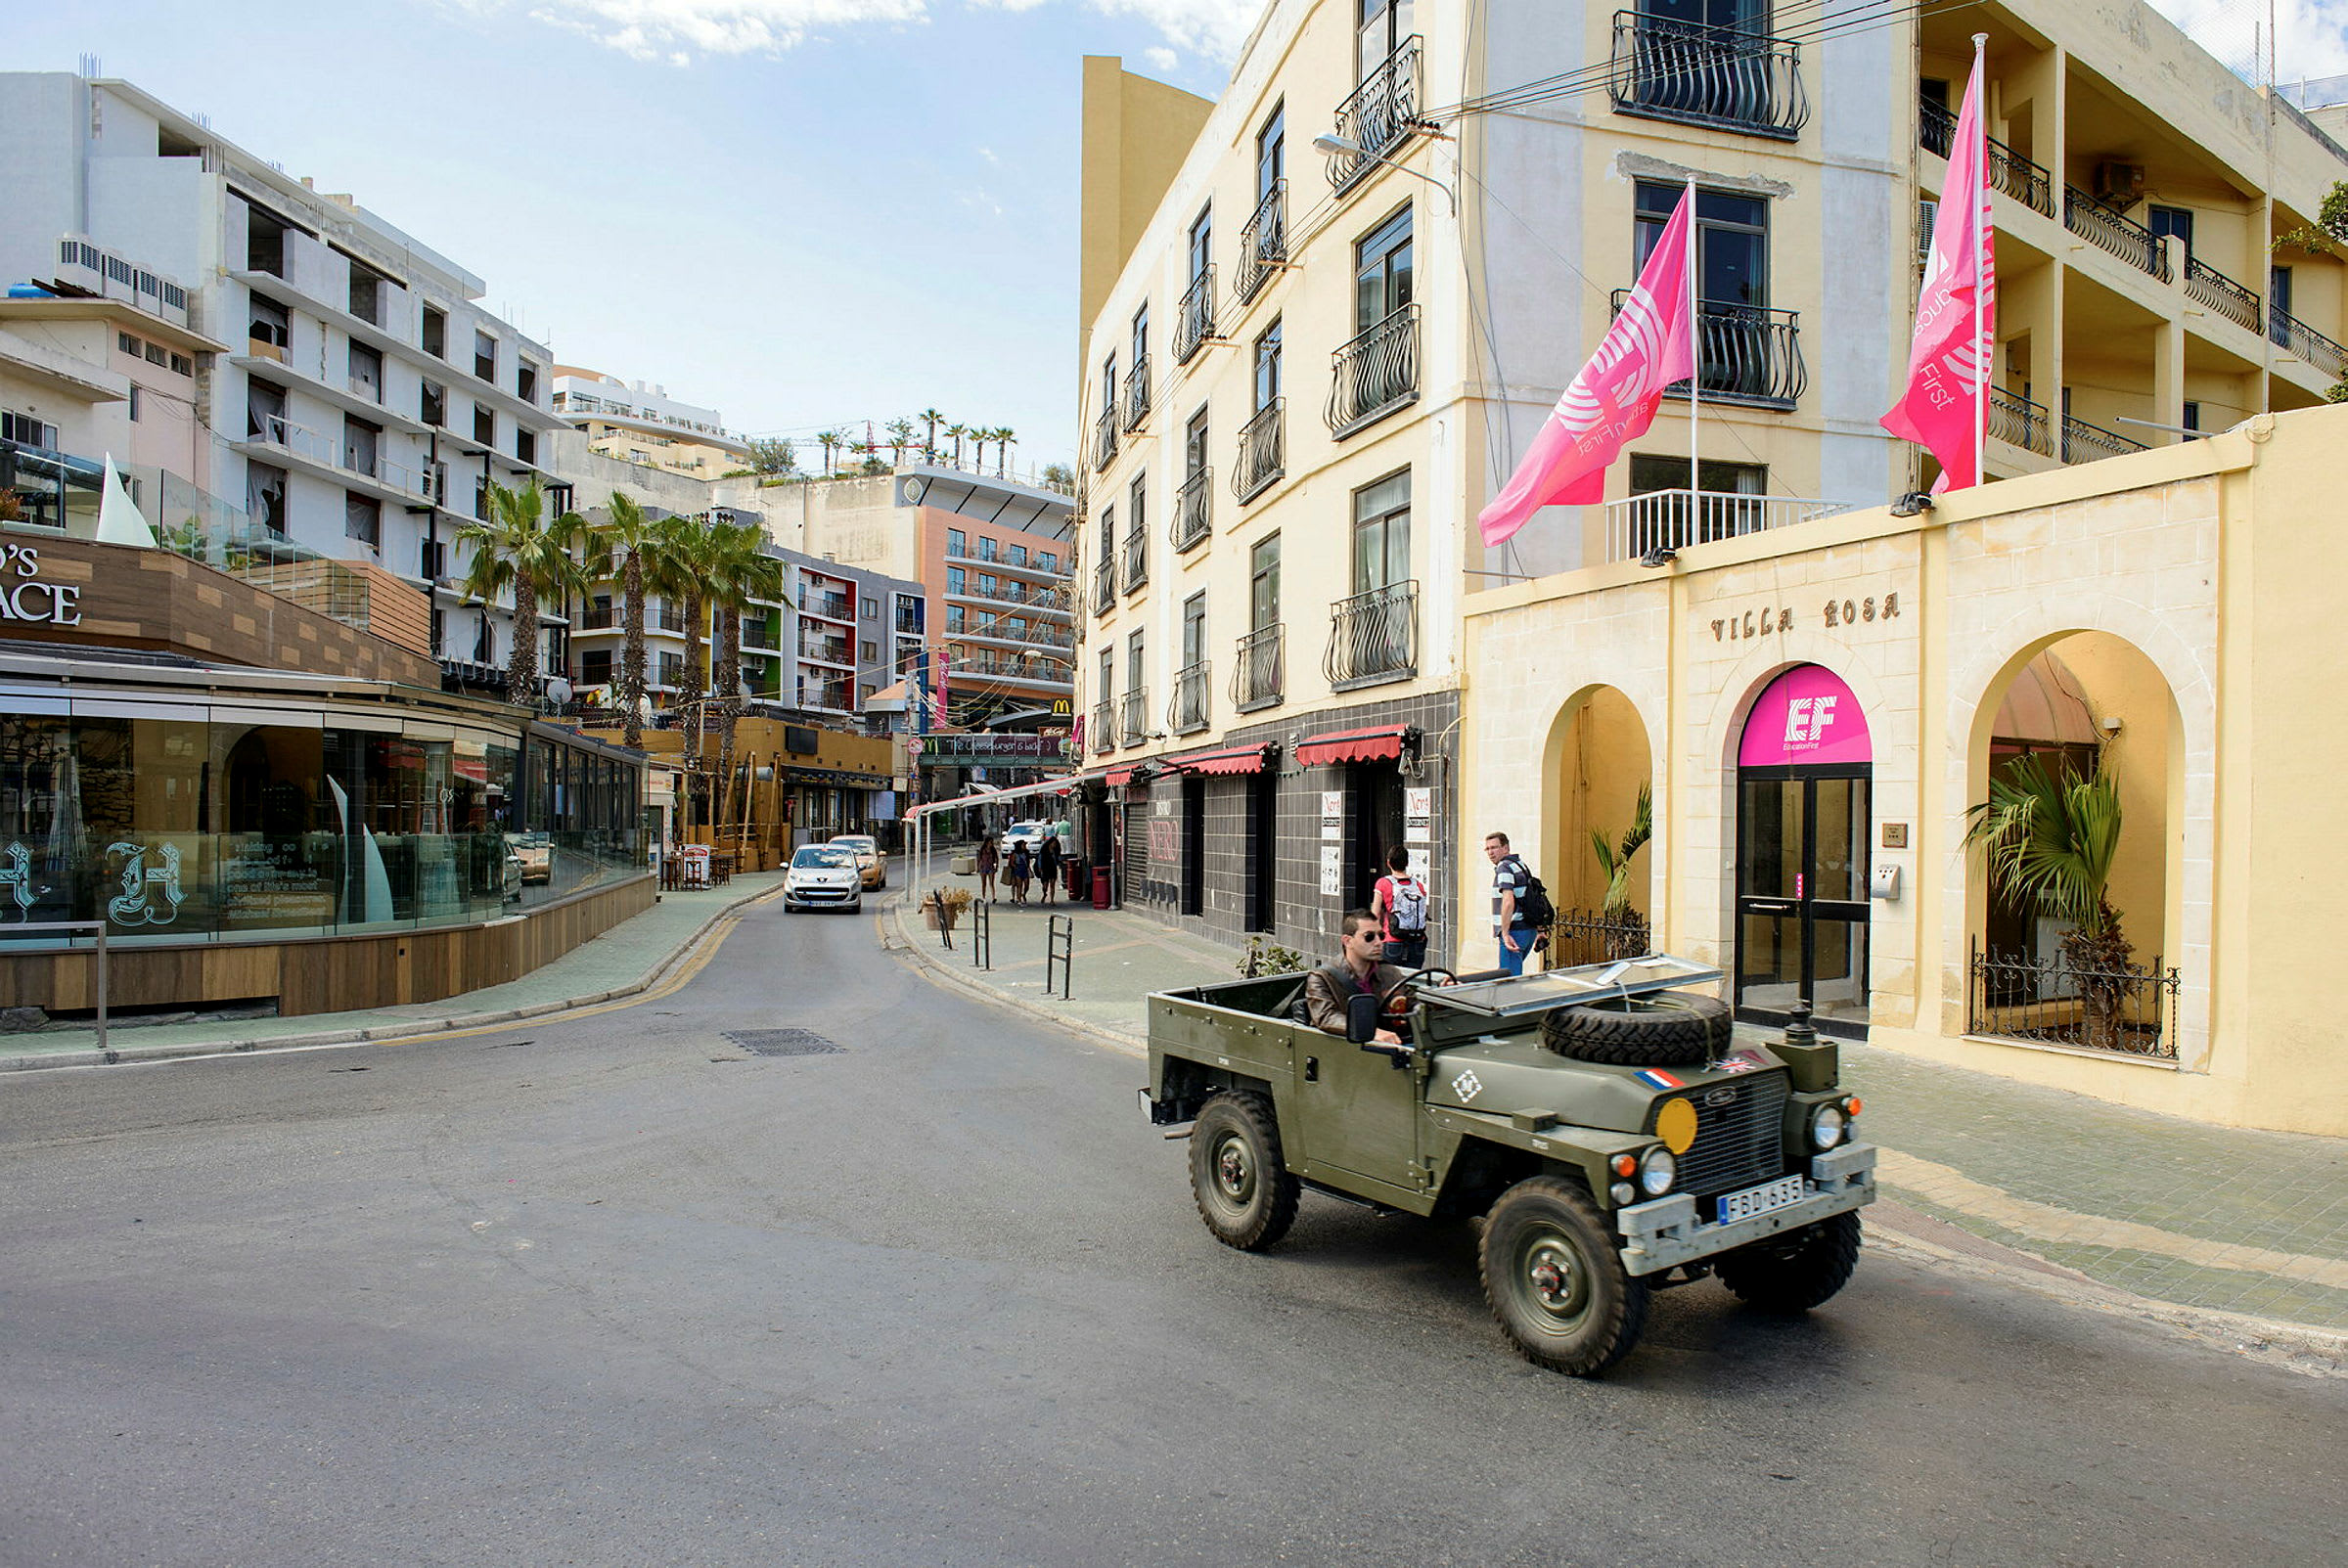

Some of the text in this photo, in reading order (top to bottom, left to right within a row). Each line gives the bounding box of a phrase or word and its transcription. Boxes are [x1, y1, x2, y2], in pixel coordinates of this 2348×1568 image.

[1919, 363, 1956, 412] First
[1711, 592, 1900, 642] VILLA ROSA
[1784, 695, 1837, 741] EF
[1149, 821, 1179, 861] NERO
